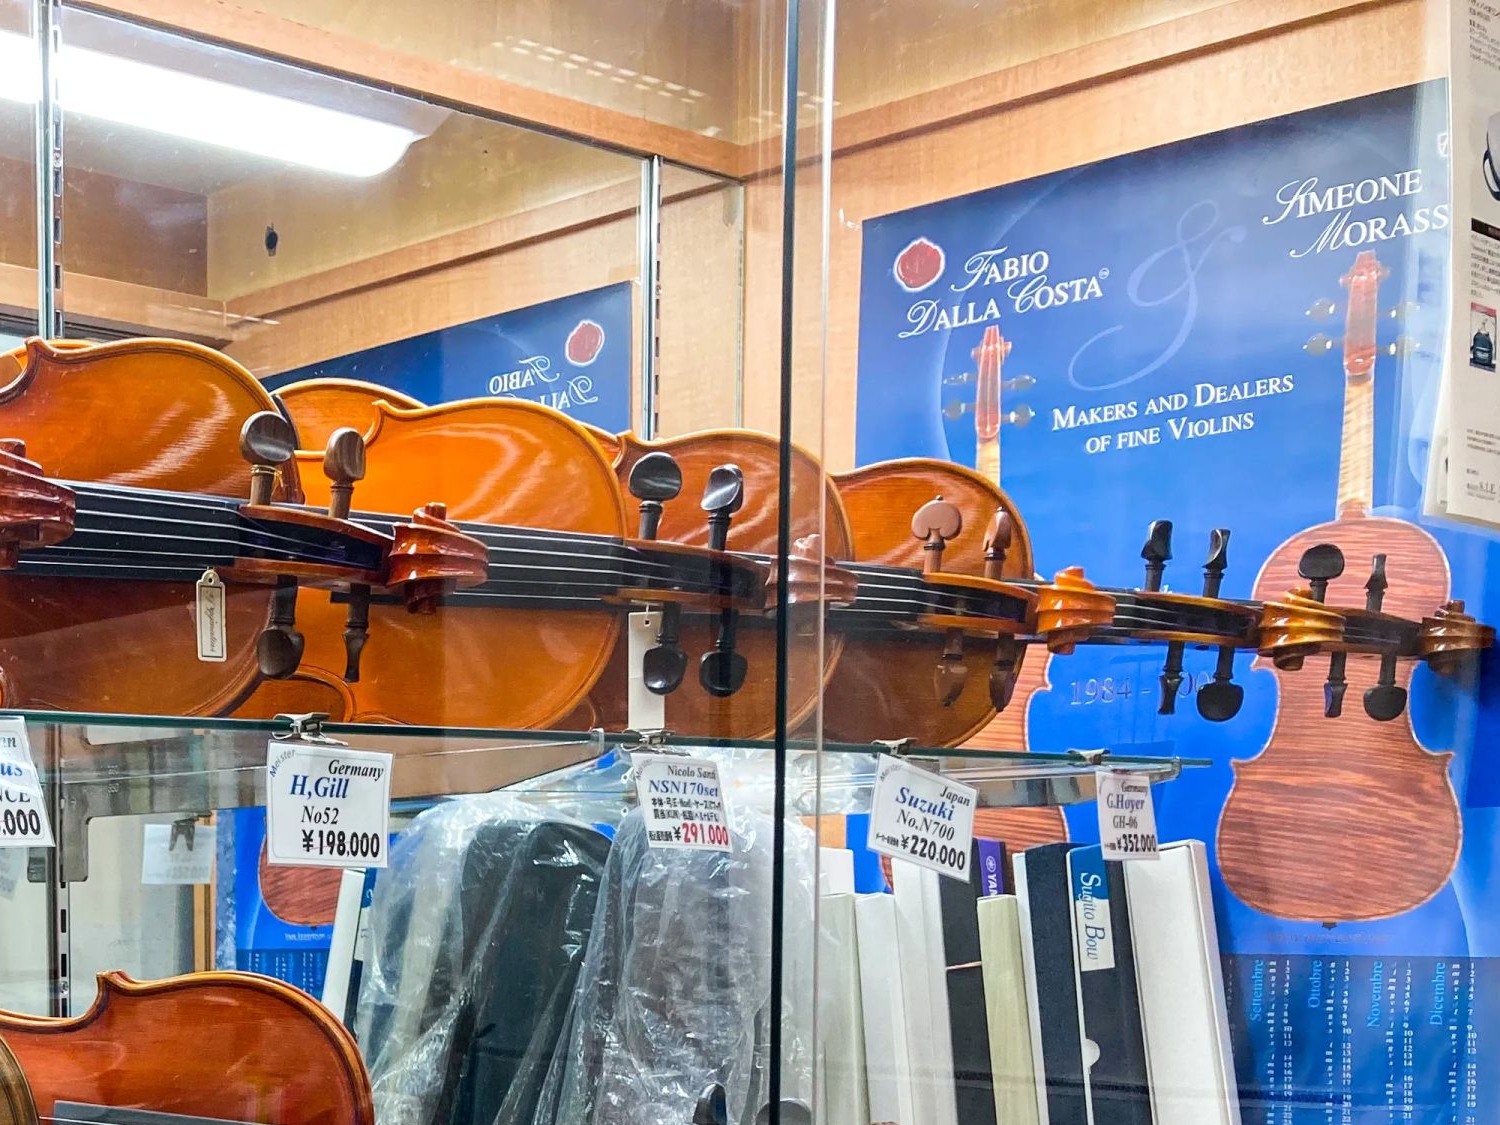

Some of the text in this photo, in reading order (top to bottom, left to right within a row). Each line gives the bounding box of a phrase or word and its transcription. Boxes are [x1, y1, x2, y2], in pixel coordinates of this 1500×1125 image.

[1262, 169, 1422, 225] SIMEONE
[950, 247, 1049, 293] FABIO
[898, 299, 1001, 339] DALLA
[1051, 373, 1294, 431] MAKERS AND DEALERS
[1085, 411, 1254, 454] OF FINE VIOLINS
[328, 760, 384, 781] Germany
[649, 780, 718, 797] NSN170set
[895, 786, 955, 821] Suzuki
[940, 786, 970, 806] Japan
[301, 806, 340, 824] No52
[896, 809, 954, 841] No.N700
[1084, 924, 1105, 960] Bow
[1367, 960, 1383, 1028] Novembre
